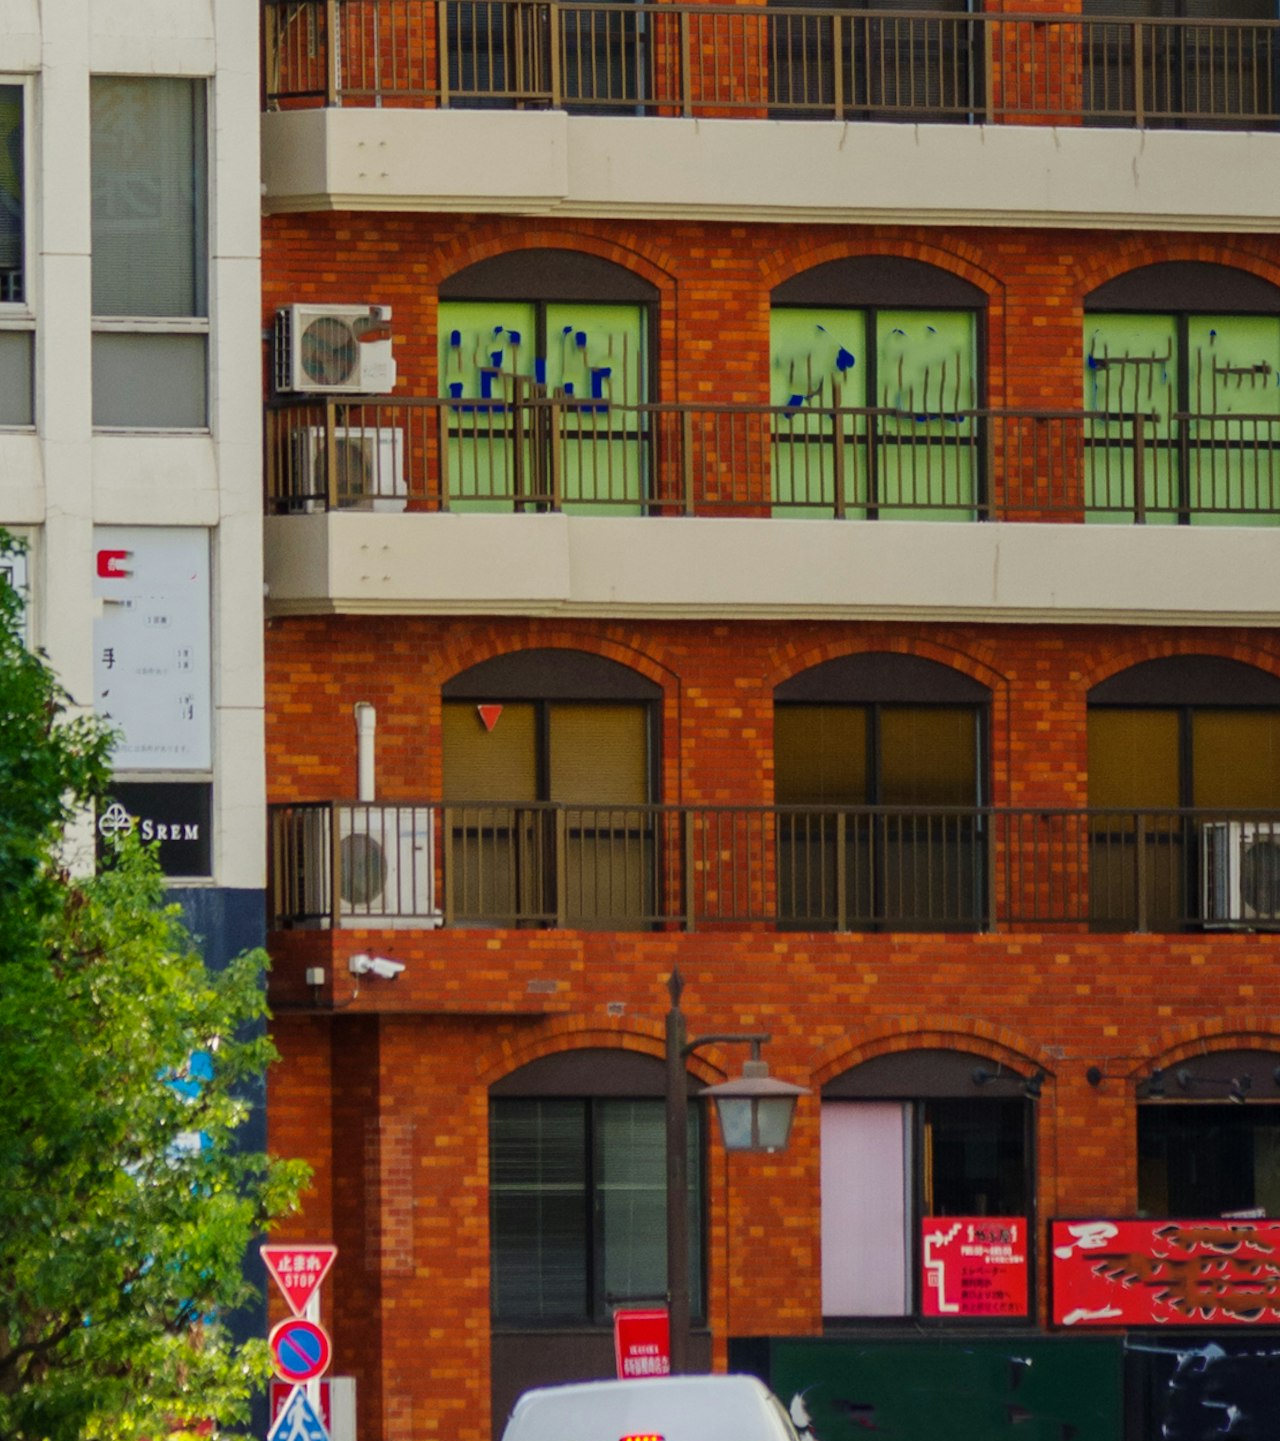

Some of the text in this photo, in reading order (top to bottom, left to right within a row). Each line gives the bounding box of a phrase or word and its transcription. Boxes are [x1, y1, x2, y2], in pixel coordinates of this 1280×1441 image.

[277, 1254, 322, 1272] 止まれ
[284, 1273, 315, 1289] STOP
